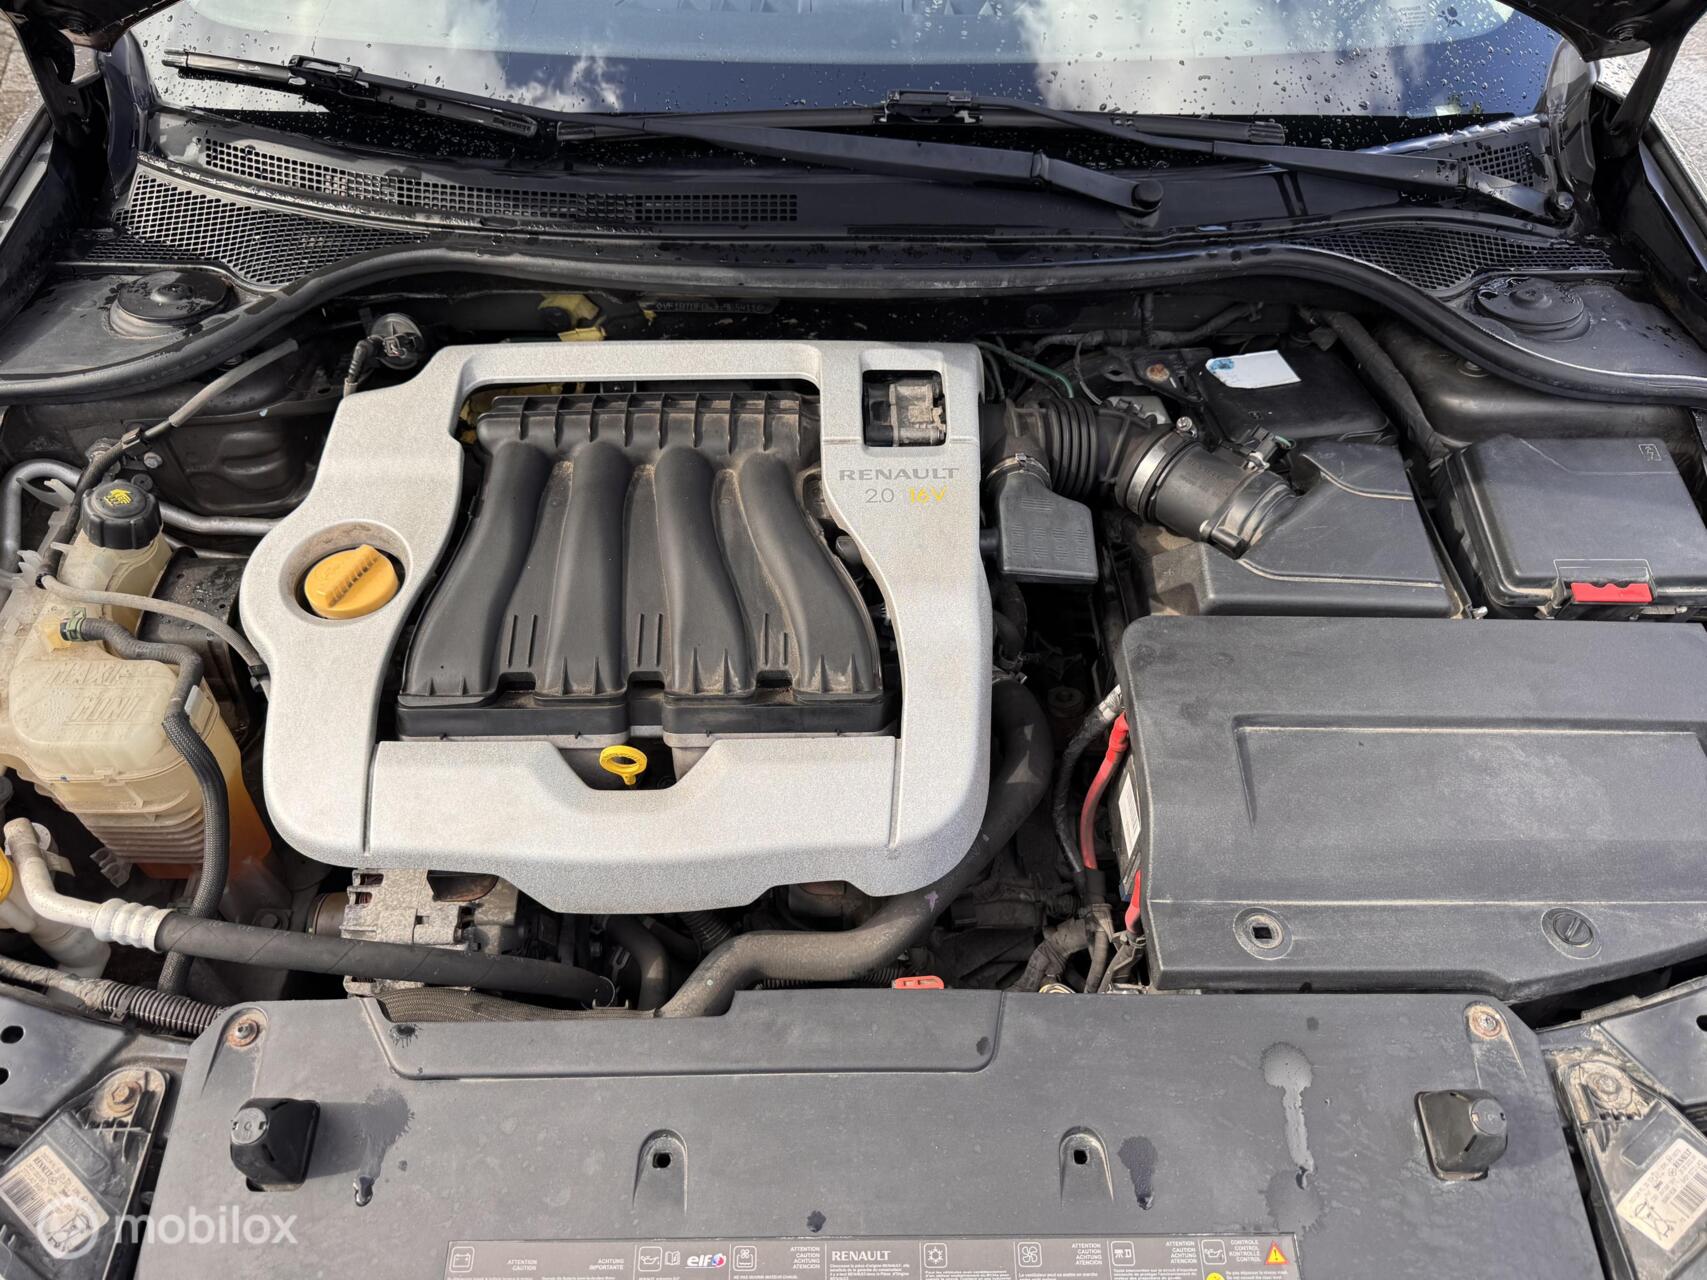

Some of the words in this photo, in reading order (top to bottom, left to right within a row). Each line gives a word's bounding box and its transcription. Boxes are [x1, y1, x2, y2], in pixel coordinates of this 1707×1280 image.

[839, 467, 960, 481] RENAULT
[865, 488, 895, 503] 2.0
[908, 487, 948, 504] 16V
[686, 1254, 713, 1267] elf
[831, 1250, 892, 1261] RENAULT
